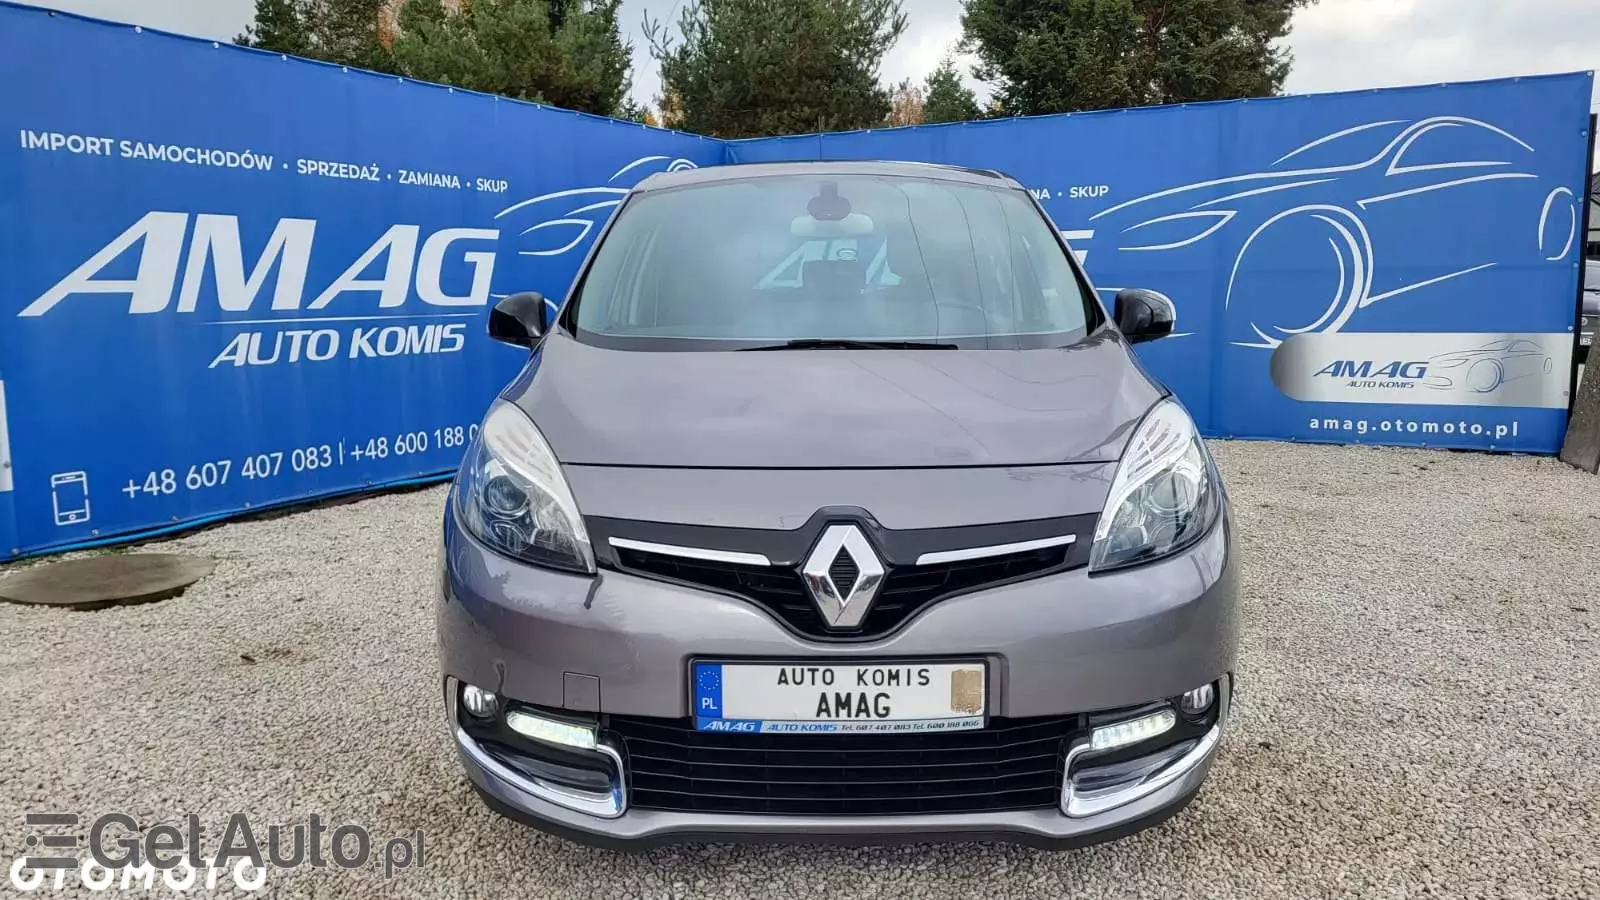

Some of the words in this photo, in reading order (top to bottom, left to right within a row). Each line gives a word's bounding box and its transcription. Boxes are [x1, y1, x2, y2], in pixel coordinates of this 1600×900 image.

[20, 130, 113, 156] IMPORT
[119, 141, 273, 171] SAMOCHODÓW
[297, 159, 380, 181] SPRZEDAŻ
[398, 170, 460, 188] ZAMIANA
[476, 178, 508, 193] SKUP
[1069, 185, 1109, 198] SKUP
[208, 327, 340, 368] AUTO
[349, 323, 466, 359] KOMIS
[1313, 360, 1429, 378] AMAG
[1345, 380, 1376, 388] AUTO
[1378, 380, 1415, 388] KOMIS
[1309, 417, 1519, 439] amag.otomoto.pl
[122, 468, 177, 499] +48
[185, 460, 231, 489] 607
[241, 452, 284, 480] 407
[291, 444, 333, 471] 083
[350, 436, 388, 461] +48
[394, 431, 428, 456] 600
[433, 426, 464, 449] 188
[777, 667, 834, 685] AUTO
[857, 668, 930, 686] KOMIS
[702, 697, 717, 710] PL
[816, 692, 891, 718] AMAG
[704, 720, 756, 731] AMAG
[767, 723, 798, 731] AUTO
[800, 723, 838, 732] KOMIS
